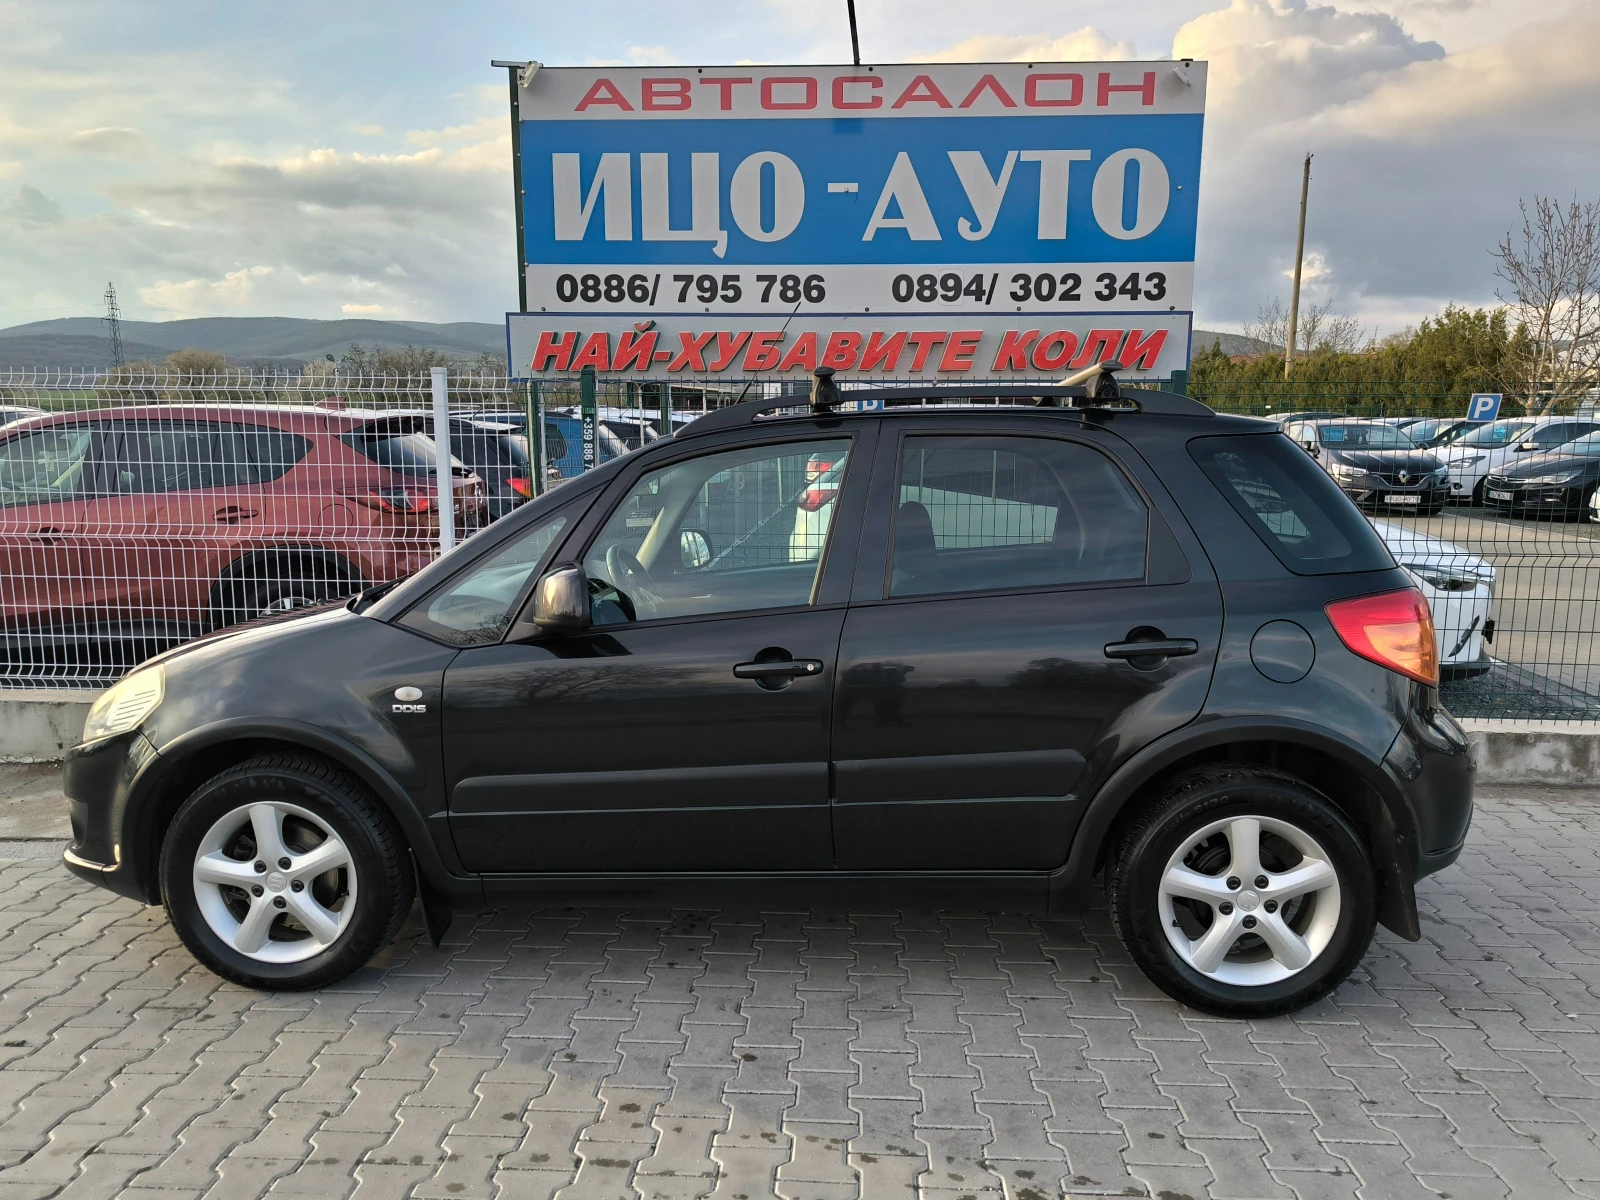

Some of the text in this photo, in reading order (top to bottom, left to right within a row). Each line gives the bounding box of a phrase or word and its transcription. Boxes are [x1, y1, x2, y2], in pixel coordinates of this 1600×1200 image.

[573, 71, 1156, 112] АВТОСАЛОН
[556, 274, 826, 305] 0886/ 795 786
[892, 271, 1167, 305] 0894/ 302 343
[530, 319, 1169, 372] НАЙ-ХУБАВИТЕ КОЛИ
[1473, 397, 1494, 419] P
[583, 416, 593, 440] +359
[583, 442, 594, 461] 886
